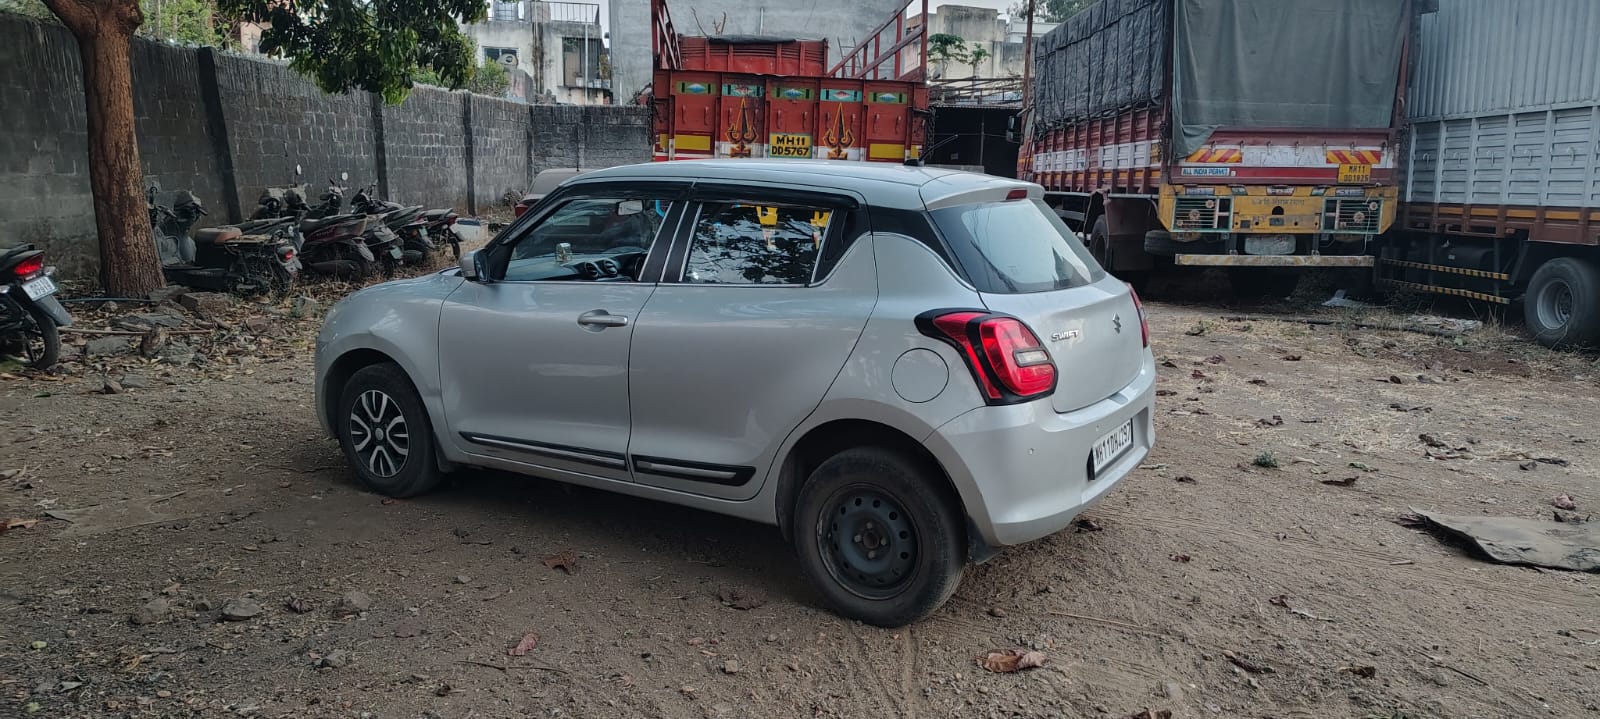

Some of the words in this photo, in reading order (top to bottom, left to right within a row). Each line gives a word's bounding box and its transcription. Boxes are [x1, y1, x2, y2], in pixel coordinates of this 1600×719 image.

[776, 135, 806, 146] MH11
[771, 145, 809, 156] DD5767
[1208, 168, 1228, 176] PERMIT
[1051, 329, 1079, 343] SWIFT
